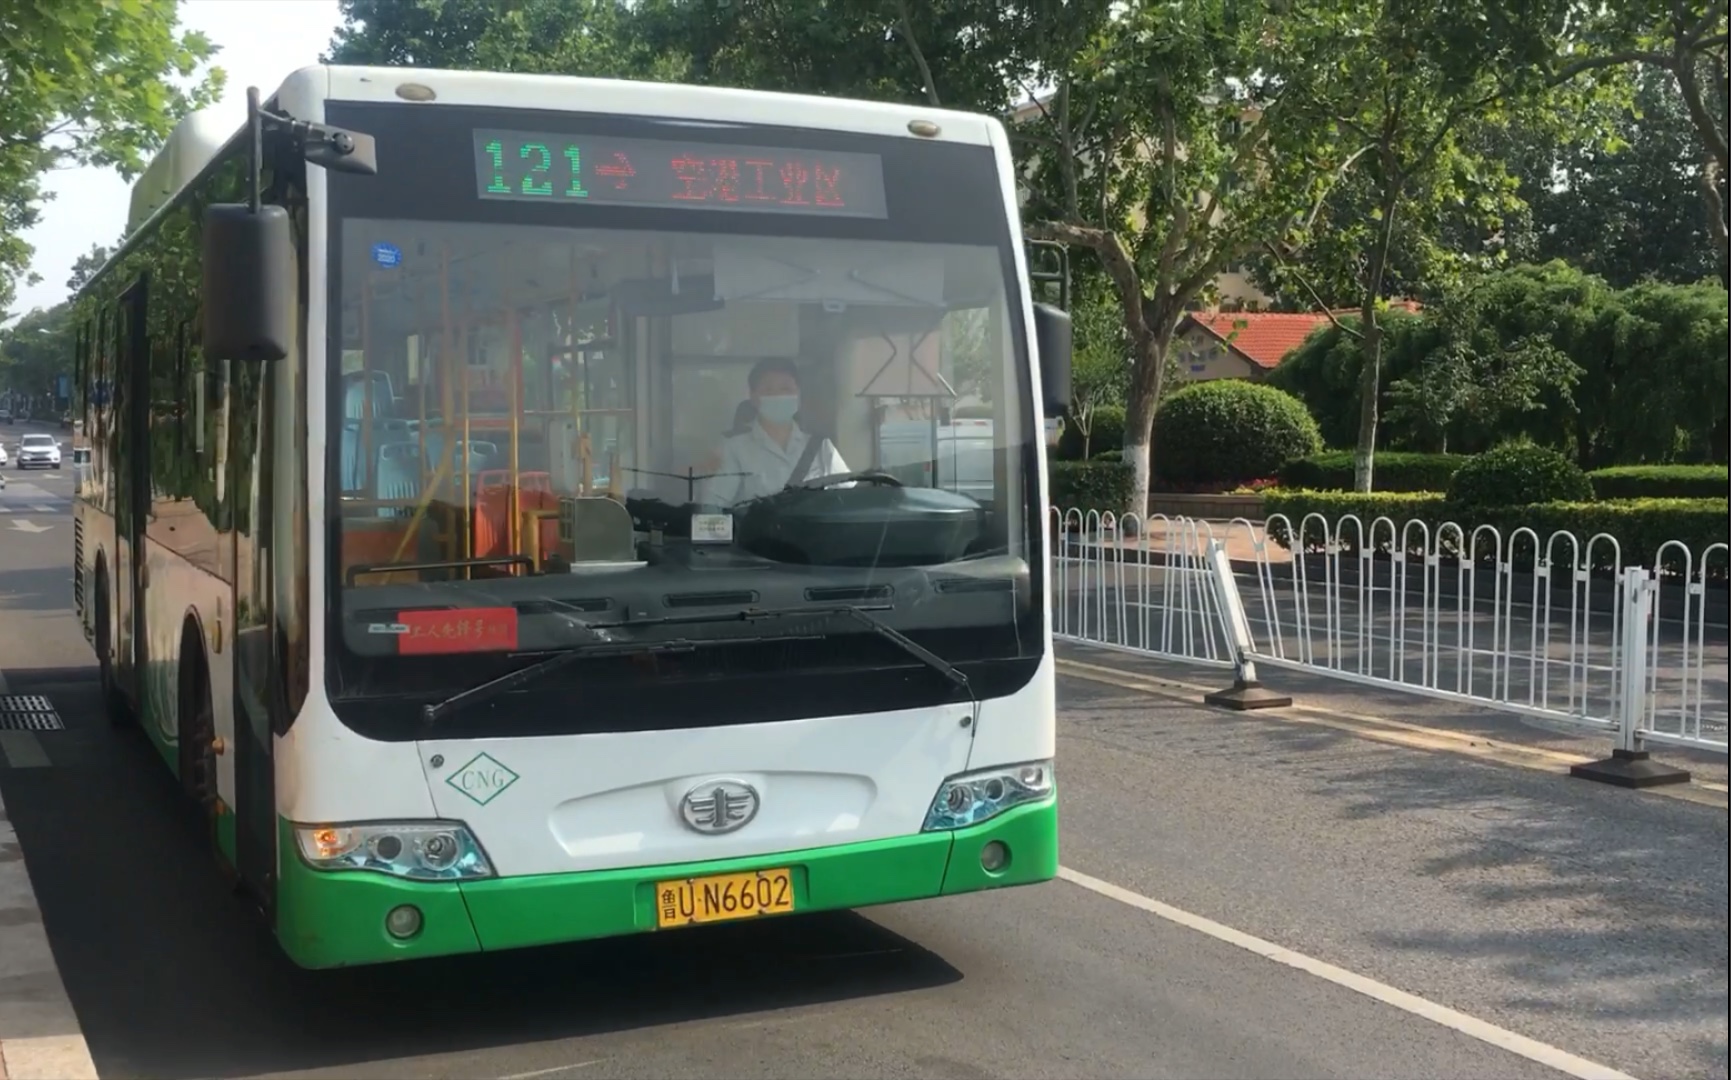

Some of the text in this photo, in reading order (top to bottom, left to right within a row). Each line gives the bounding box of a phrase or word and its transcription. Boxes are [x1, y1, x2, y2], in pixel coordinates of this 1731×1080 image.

[486, 140, 845, 206] 121 空港工业区
[462, 768, 504, 790] CNG
